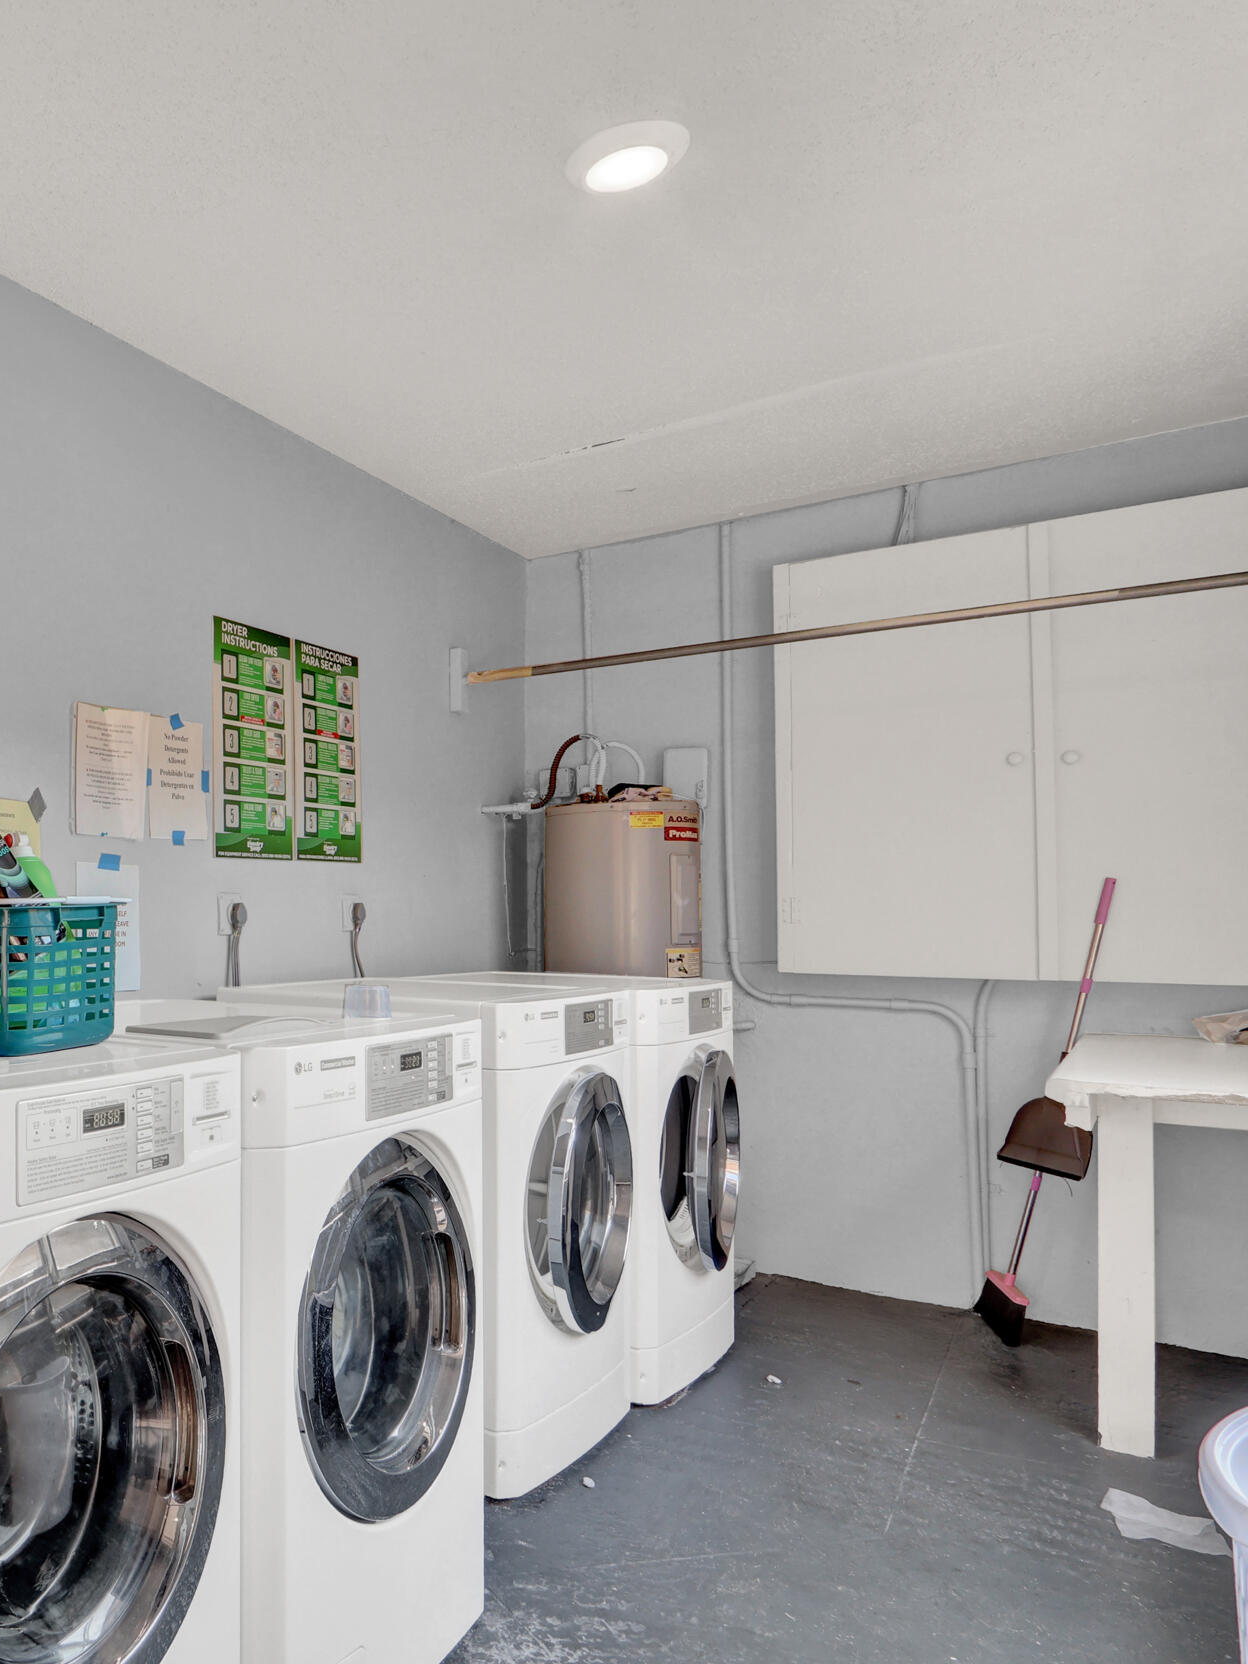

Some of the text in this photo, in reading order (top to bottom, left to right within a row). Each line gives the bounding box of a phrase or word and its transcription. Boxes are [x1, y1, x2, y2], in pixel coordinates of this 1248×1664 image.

[221, 621, 248, 637] DRYER
[221, 632, 278, 657] INSTRUCTIONS
[301, 643, 352, 666] INSTRUCCIONES
[228, 660, 232, 674] 1
[301, 654, 342, 674] PARA SECAR
[228, 695, 233, 711] 2
[307, 711, 312, 726] 2
[229, 734, 234, 748] 3
[229, 771, 234, 786] 4
[230, 808, 235, 823] 5
[303, 1062, 313, 1072] LG
